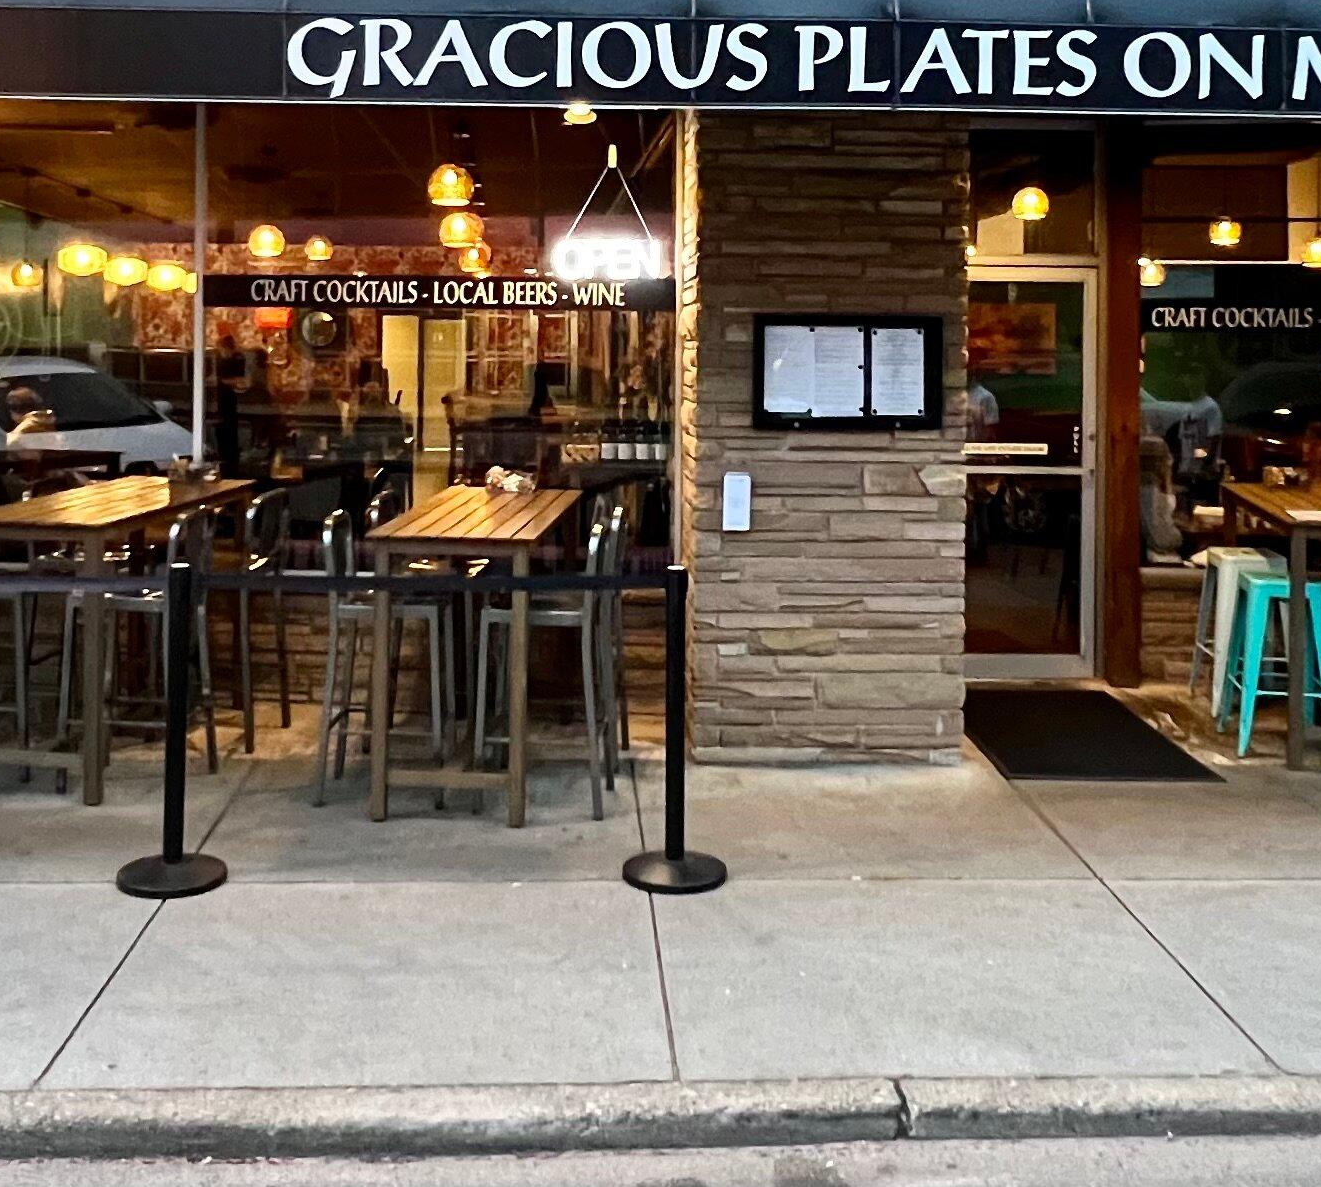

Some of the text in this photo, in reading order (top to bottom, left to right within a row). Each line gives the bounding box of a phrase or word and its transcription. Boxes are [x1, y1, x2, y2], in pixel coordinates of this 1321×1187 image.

[286, 17, 769, 98] GRACIOUS
[794, 25, 1098, 97] PLATES
[1123, 30, 1265, 99] ON
[552, 238, 663, 281] OPEN
[250, 279, 309, 302] CRAFT
[313, 279, 418, 304] COCKTAILS
[433, 280, 499, 305] LOCAL
[503, 281, 558, 305] BEERS
[572, 282, 626, 307] WINE
[1151, 307, 1207, 327] CRAFT
[1212, 307, 1314, 328] COCKTAILS
